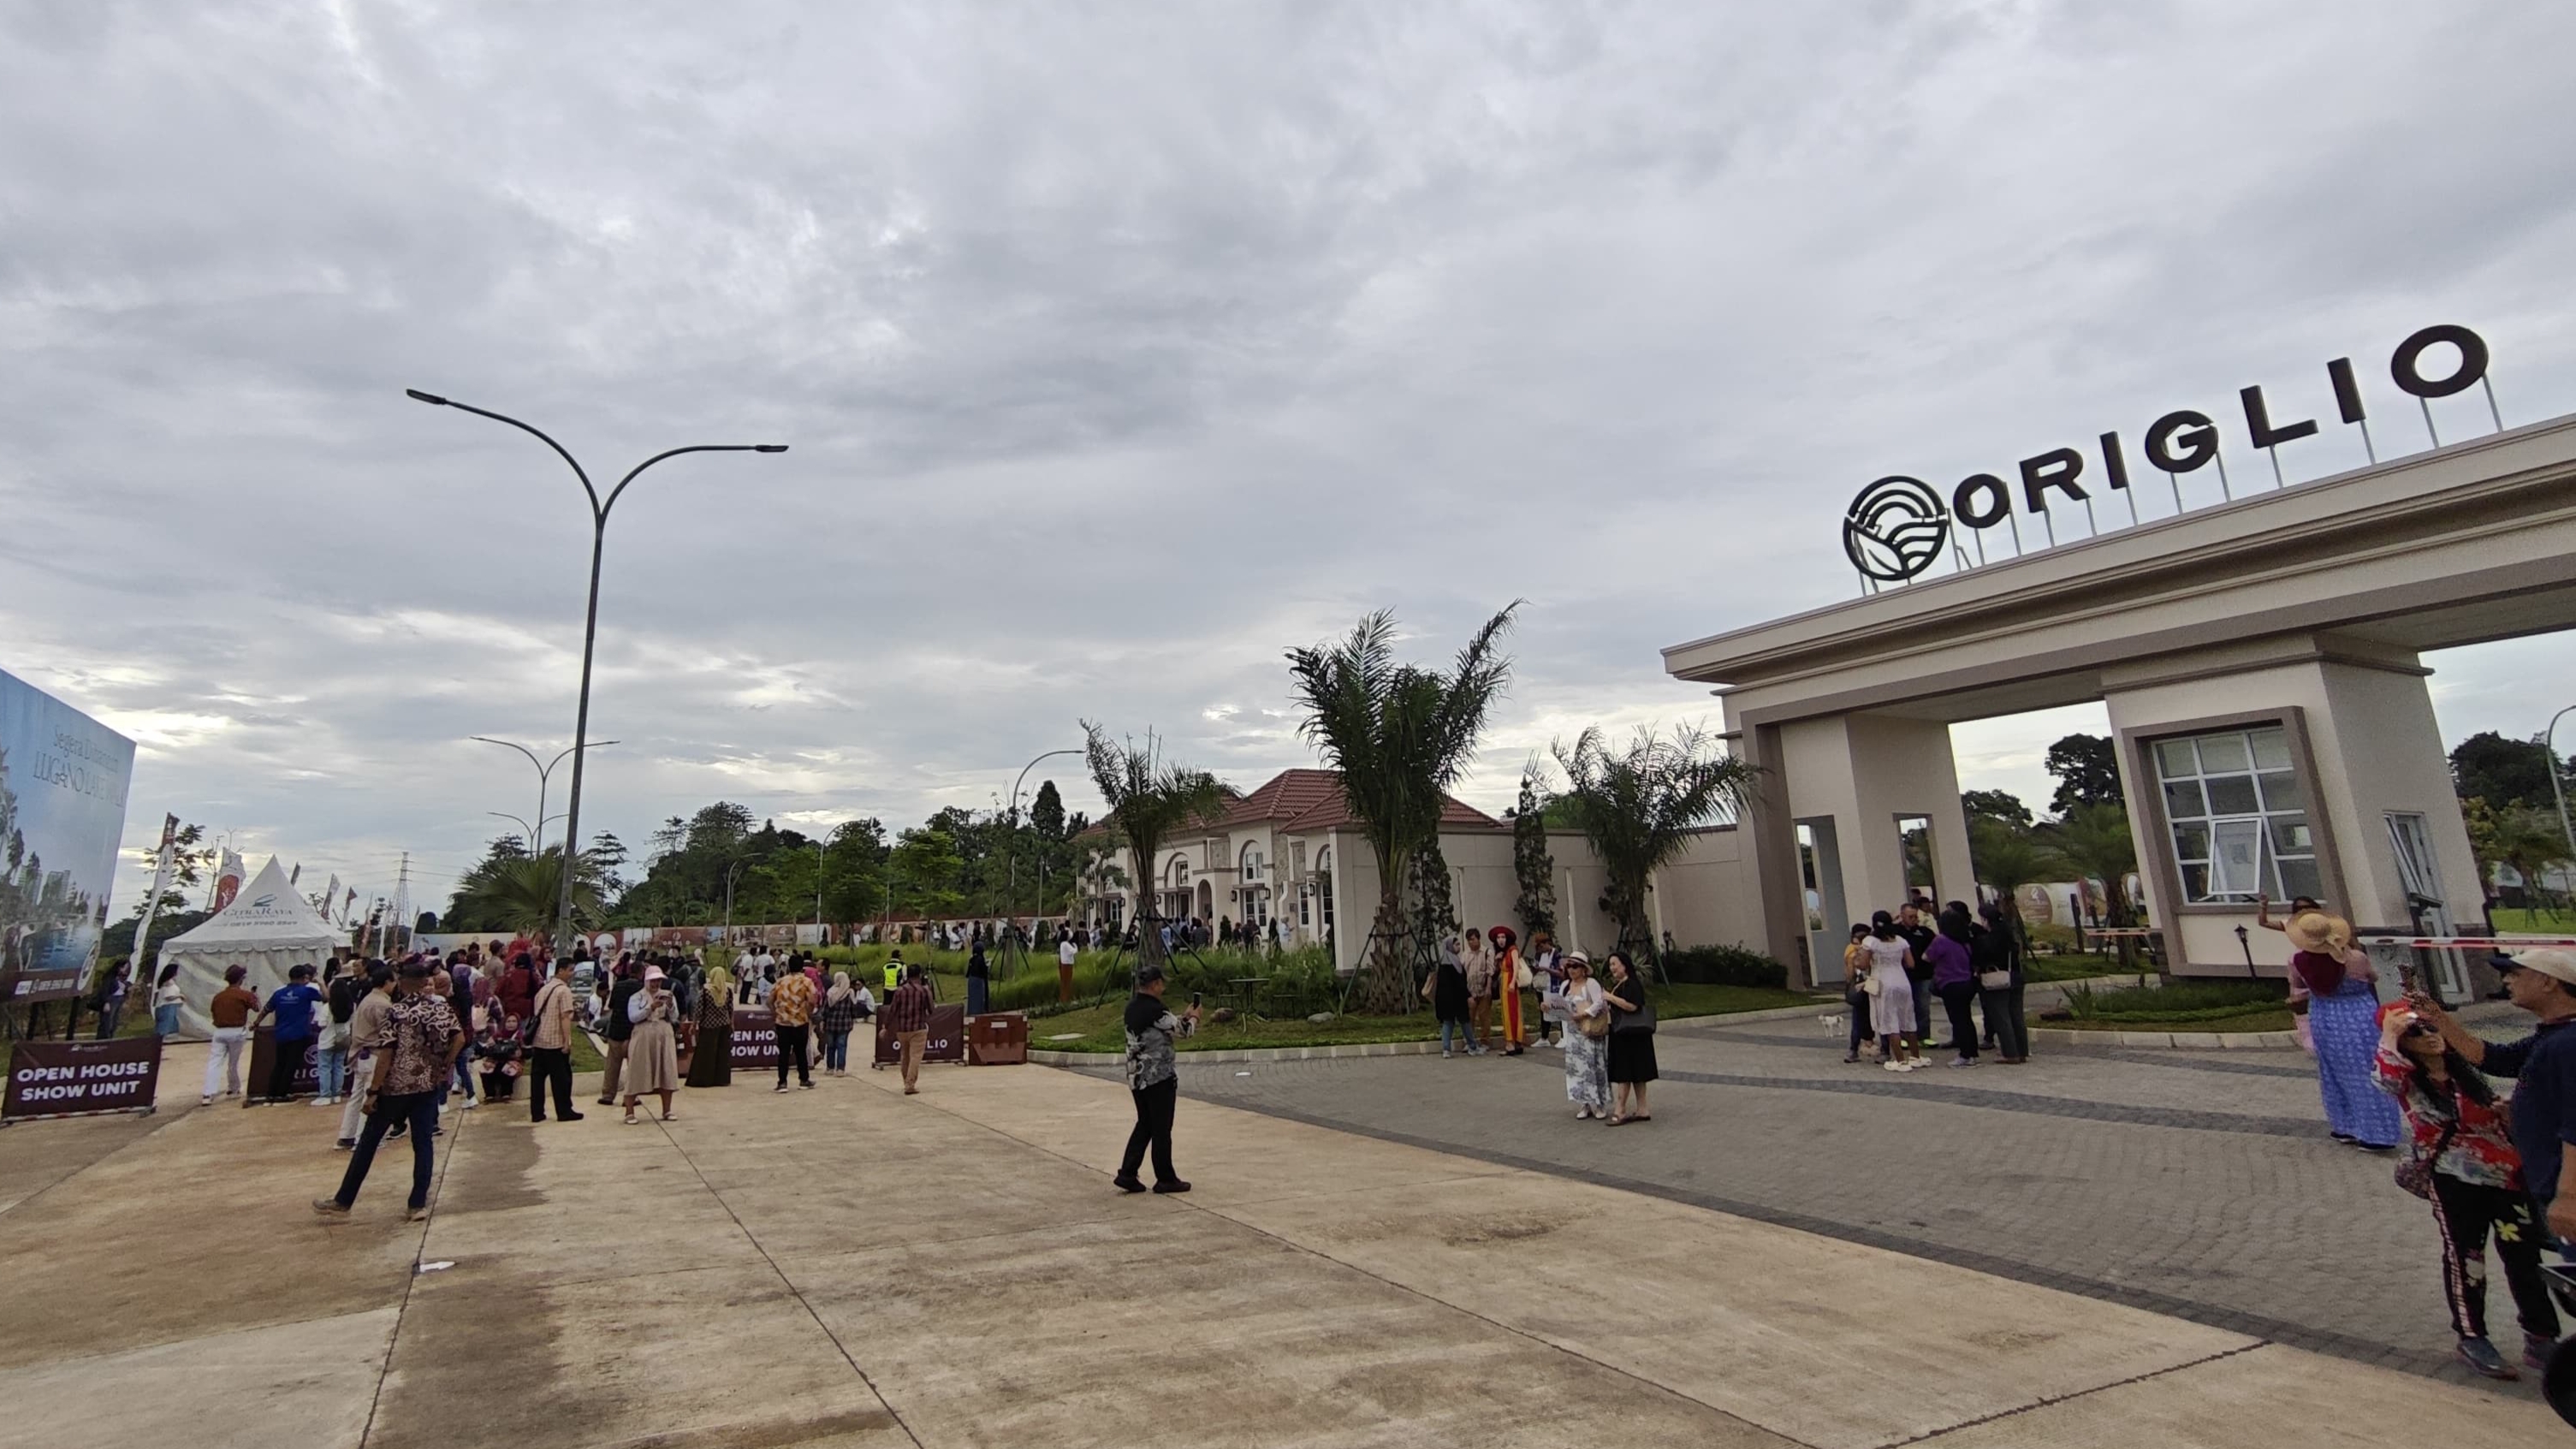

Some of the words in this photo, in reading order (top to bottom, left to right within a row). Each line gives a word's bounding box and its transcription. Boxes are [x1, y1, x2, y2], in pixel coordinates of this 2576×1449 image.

[1952, 324, 2490, 530] ORIGLIO
[731, 1045, 760, 1057] HOW
[17, 1066, 75, 1083] OPEN
[80, 1061, 150, 1078] HOUSE
[21, 1084, 86, 1102] SHOW
[92, 1080, 140, 1096] UNIT
